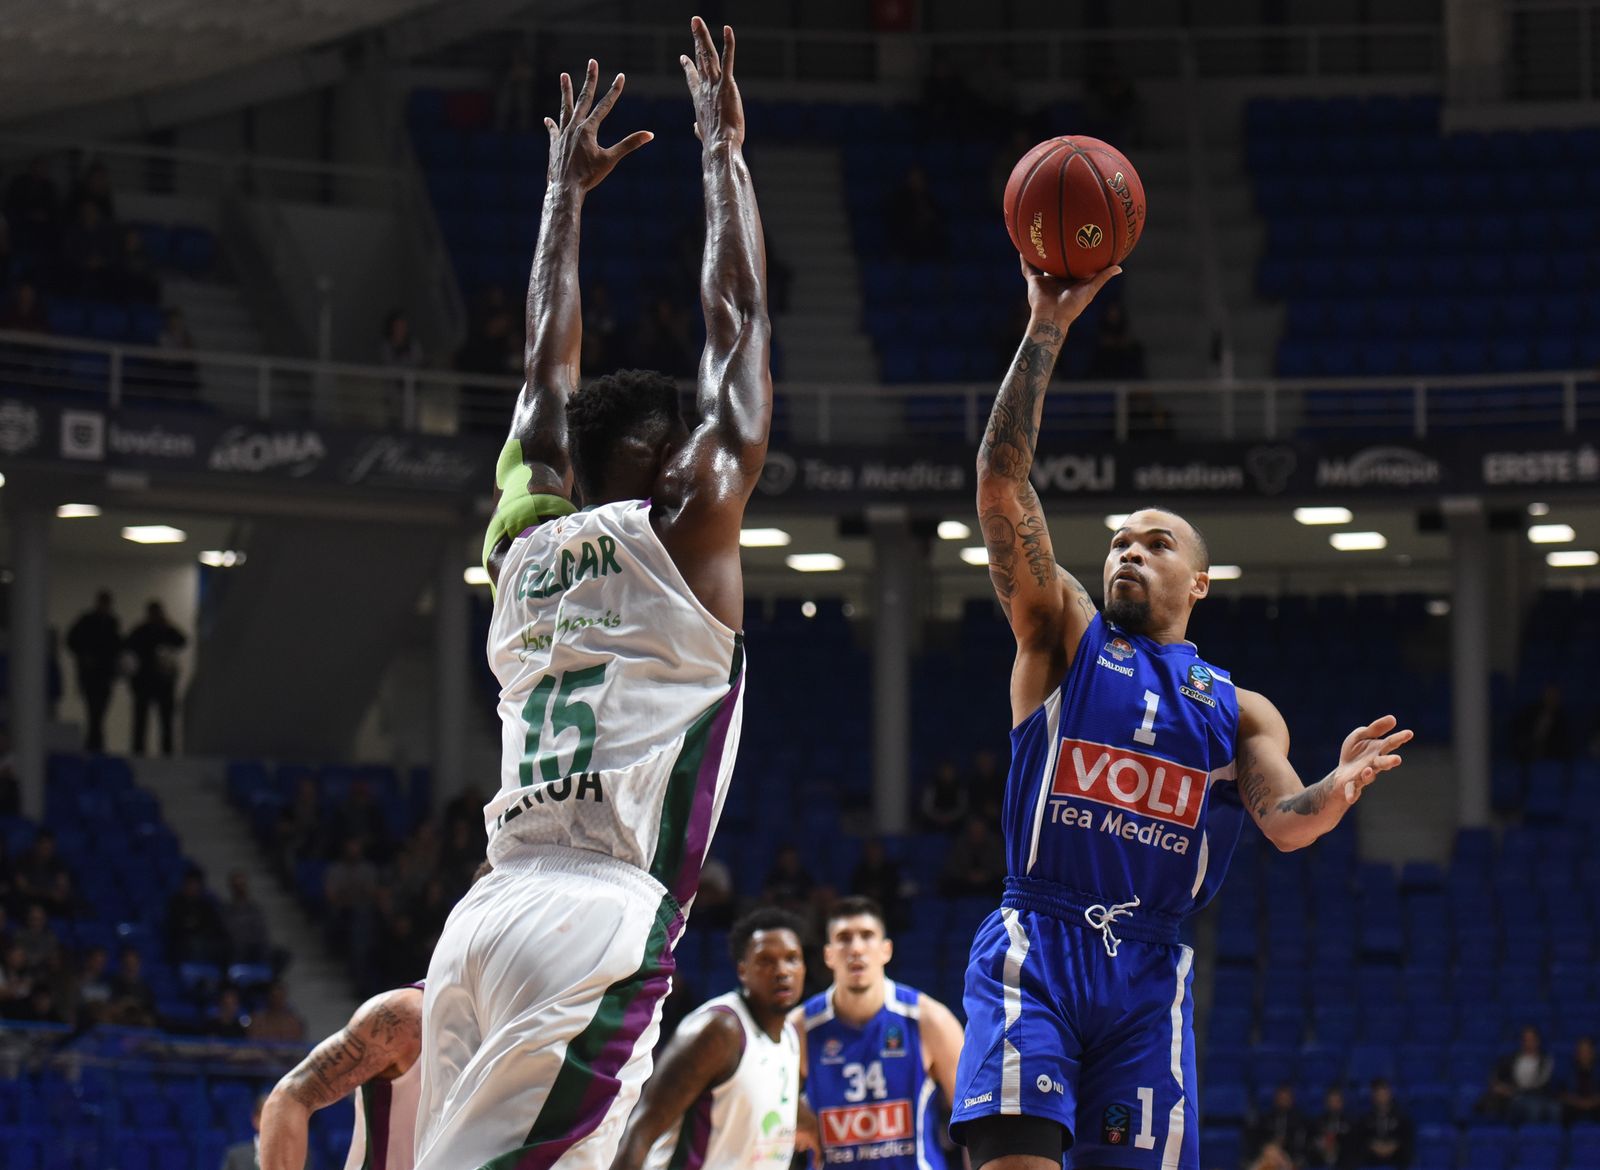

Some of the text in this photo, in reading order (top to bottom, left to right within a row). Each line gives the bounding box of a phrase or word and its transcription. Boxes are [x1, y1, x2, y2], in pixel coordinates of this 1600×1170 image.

[802, 458, 966, 491] Tea Medica
[1032, 454, 1116, 491] VOLI
[1482, 450, 1571, 485] ERSTE
[1097, 655, 1135, 678] SPALDING
[1179, 686, 1216, 708] oneteam
[519, 663, 607, 789] 15
[1133, 689, 1160, 746] 1
[1072, 747, 1193, 817] VOLI
[1050, 800, 1190, 855] Tea Medica
[842, 1060, 888, 1102] 34
[964, 1091, 993, 1109] SPALDING
[1134, 1086, 1156, 1150] 1
[827, 1106, 905, 1140] VOLI
[825, 1139, 915, 1164] Tea Medica
